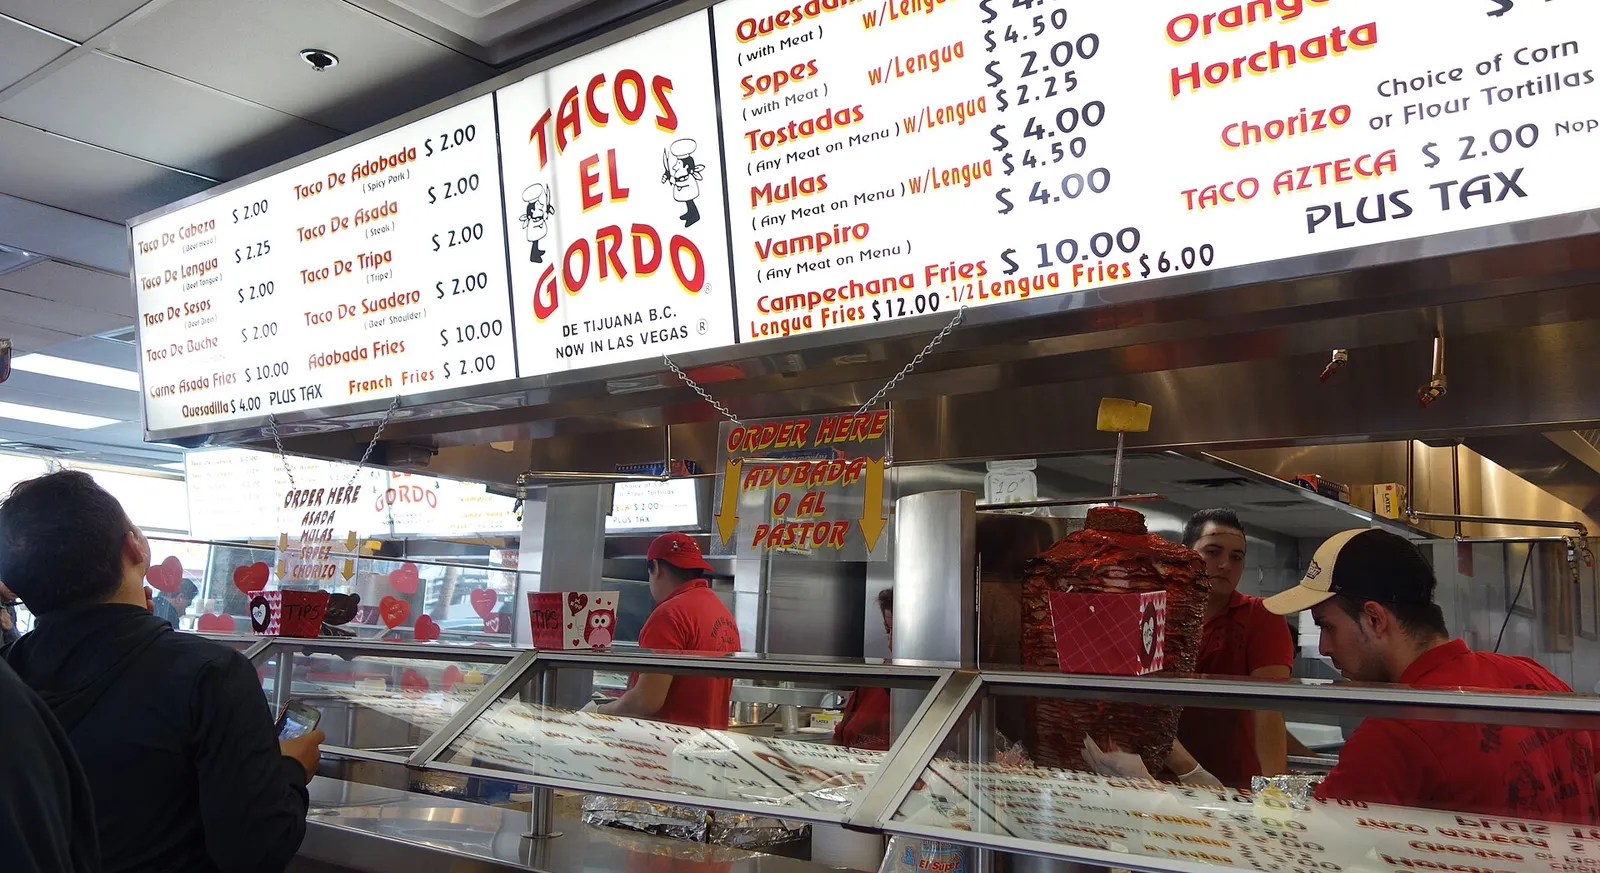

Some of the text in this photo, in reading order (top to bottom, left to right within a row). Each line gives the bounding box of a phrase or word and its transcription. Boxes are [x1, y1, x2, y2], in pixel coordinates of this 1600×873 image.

[746, 44, 775, 62] with
[780, 30, 814, 51] Meat
[1164, 0, 1330, 47] Orang
[740, 33, 1100, 100] Sopes w/Lengua $ 2.00
[1170, 21, 1378, 101] Horchata
[1377, 40, 1579, 99] Choice of Corn
[529, 68, 678, 171] TACOS
[751, 100, 780, 118] with
[785, 88, 819, 107] Meat
[1368, 67, 1595, 131] or Flour Tortillas
[744, 100, 1105, 153] Tostadas $ 4.00
[756, 157, 782, 173] Any
[786, 146, 820, 165] Meat
[825, 141, 844, 153] on
[848, 128, 890, 148] Menu
[903, 95, 987, 135] w/Lengua
[1219, 103, 1352, 150] Chorizo
[294, 124, 476, 201] Taco De Adobada 2.00
[367, 172, 406, 193] Spicy Pork
[580, 148, 630, 213] EL
[1181, 176, 1259, 212] TACO
[1272, 149, 1398, 198] AZTECA
[1421, 141, 1441, 169] $
[1458, 122, 1540, 162] 2.00
[297, 173, 479, 243] Taco De Asada 2.00
[750, 167, 1111, 215] Mulas $ 4.00
[761, 158, 993, 229] Any Meat on Menu w/Lengua
[1305, 167, 1529, 235] PLUS TAX
[138, 199, 269, 255] Taco De Cabeza 2.00
[370, 224, 390, 237] Steak
[754, 222, 871, 263] Vampiro
[141, 240, 271, 292] Taco De Lengua 2.25
[300, 222, 484, 285] Taco De Tripa 2.00
[533, 223, 705, 324] GORDO
[757, 226, 1141, 316] Campechana Fries $ 10.00
[766, 246, 901, 281] Any Meat on Menu
[304, 272, 488, 327] Taco De Suadero 2.00
[370, 272, 389, 284] Tripe
[751, 313, 812, 338] Lengua
[821, 305, 866, 329] Fries
[1072, 260, 1132, 288] Fries
[144, 281, 275, 328] Taco De Sesos 2.00
[368, 310, 422, 329] Beef Shoulder
[562, 305, 677, 338] DE TIJUANA B.C.
[147, 322, 278, 362] Taco De Buche 2.00
[308, 319, 503, 372] Adobada Fries 10.00
[555, 325, 689, 360] NOW IN LAS VEGAS
[150, 361, 289, 399] Carne Asada Fries 10.00
[349, 354, 496, 395] French Fries 2.00
[182, 384, 323, 418] Quesadilla 4.00 PLUS TAX
[727, 410, 890, 453] ORDER HERE
[284, 485, 362, 509] ORDER HERE
[741, 456, 866, 495] ADOBADA
[301, 510, 336, 527] ASADA
[771, 491, 826, 521] O AL
[1384, 492, 1392, 514] LATEX
[301, 528, 334, 543] MULAS
[751, 520, 850, 552] PASTOR
[292, 564, 337, 580] CHORIZO
[284, 603, 321, 621] TIPS
[532, 609, 559, 630] TIPS
